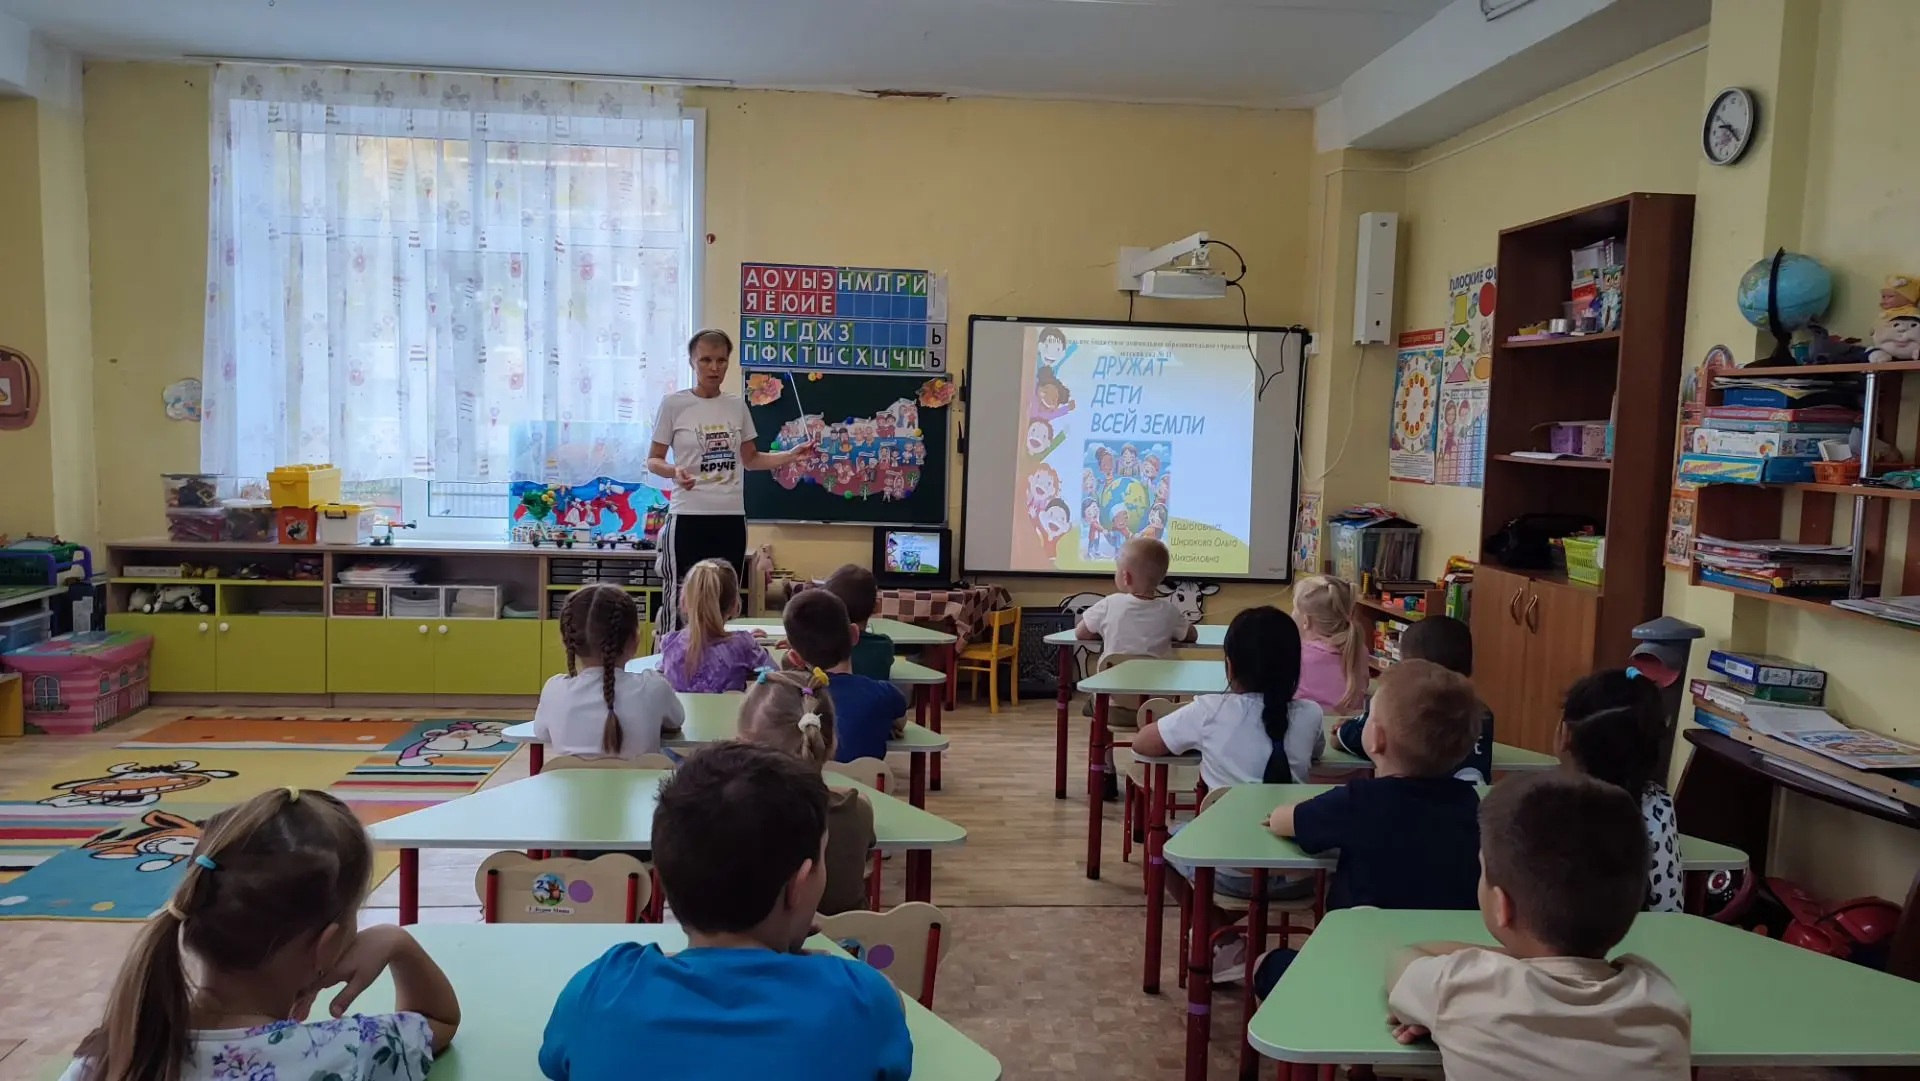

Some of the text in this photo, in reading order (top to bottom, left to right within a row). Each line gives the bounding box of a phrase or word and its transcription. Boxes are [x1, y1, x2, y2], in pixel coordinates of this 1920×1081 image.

[1092, 356, 1168, 379] ДРУЖАТ
[1091, 384, 1142, 408] ДЕТИ
[1091, 408, 1205, 435] ВСЕЙ ЗЕМЛИ
[701, 461, 736, 472] КРУЧЕ
[536, 880, 544, 888] 2
